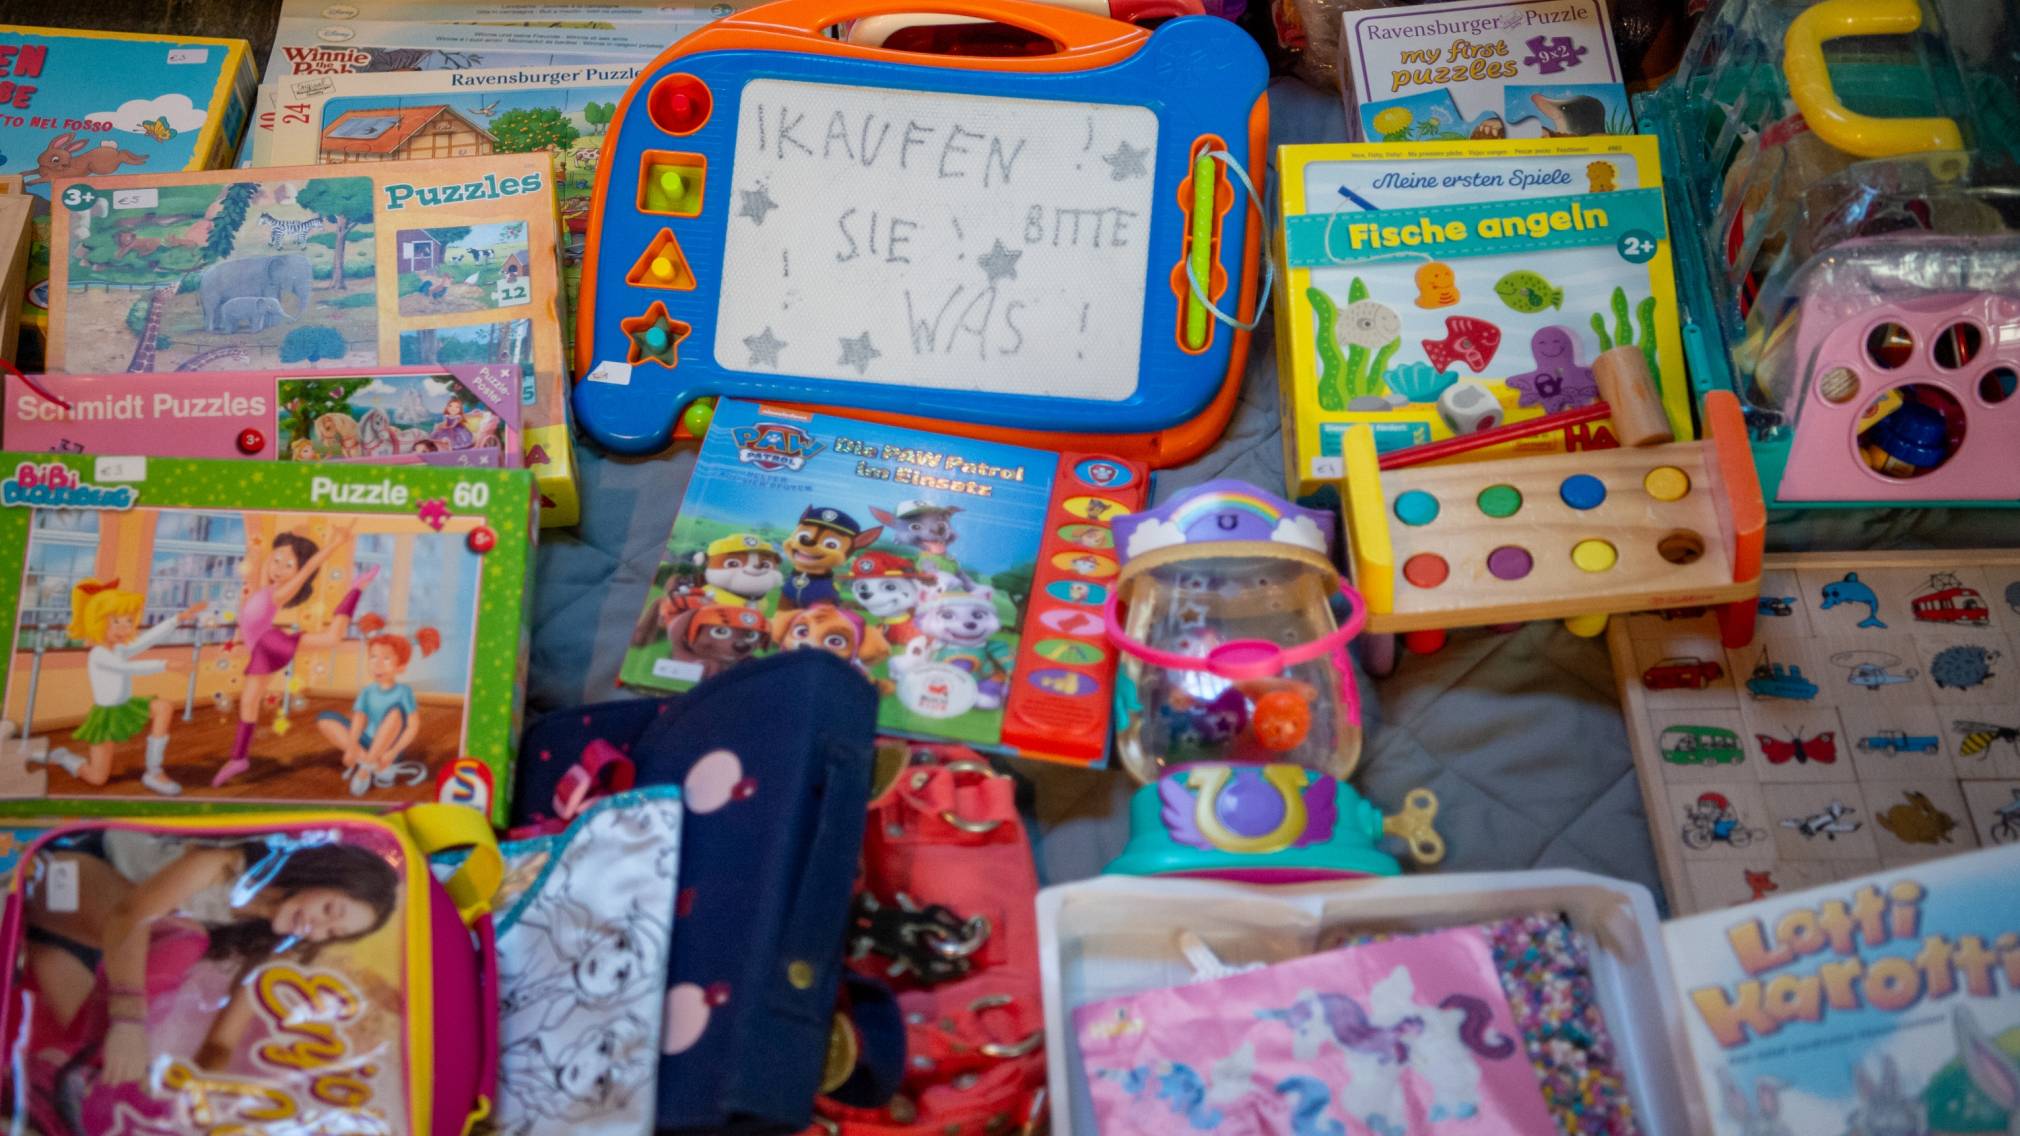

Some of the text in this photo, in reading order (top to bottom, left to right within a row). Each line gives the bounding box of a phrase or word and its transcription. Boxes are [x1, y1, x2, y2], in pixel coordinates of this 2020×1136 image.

[1368, 16, 1500, 40] Ravensburger
[1526, 5, 1589, 26] Puzzle
[282, 46, 369, 65] Winnie
[1400, 39, 1510, 65] my first
[451, 69, 581, 87] Ravensburger
[1391, 58, 1519, 92] puzzles
[63, 118, 113, 133] FOSSO
[282, 103, 311, 124] 24
[384, 172, 542, 211] Puzzles
[1372, 167, 1573, 191] Meine ersten Spiele
[64, 188, 95, 206] 3+
[835, 206, 917, 264] SIE
[1024, 204, 1138, 248] BITTE
[1348, 202, 1609, 250] Fische angeln
[1623, 235, 1654, 254] 2+
[501, 286, 528, 301] 12
[904, 283, 1026, 361] WAS
[472, 376, 502, 405] Poster
[17, 391, 267, 421] Schmidt Puzzles
[246, 433, 261, 445] 3+
[732, 427, 828, 459] PAW
[746, 451, 796, 466] PATROL
[834, 435, 1025, 482] Die PAW Patrol
[310, 476, 410, 506] Puzzle
[453, 481, 490, 508] 60
[895, 466, 993, 497] Einsatz
[1727, 880, 1925, 976] Lotti
[1692, 932, 2020, 1049] Karotti
